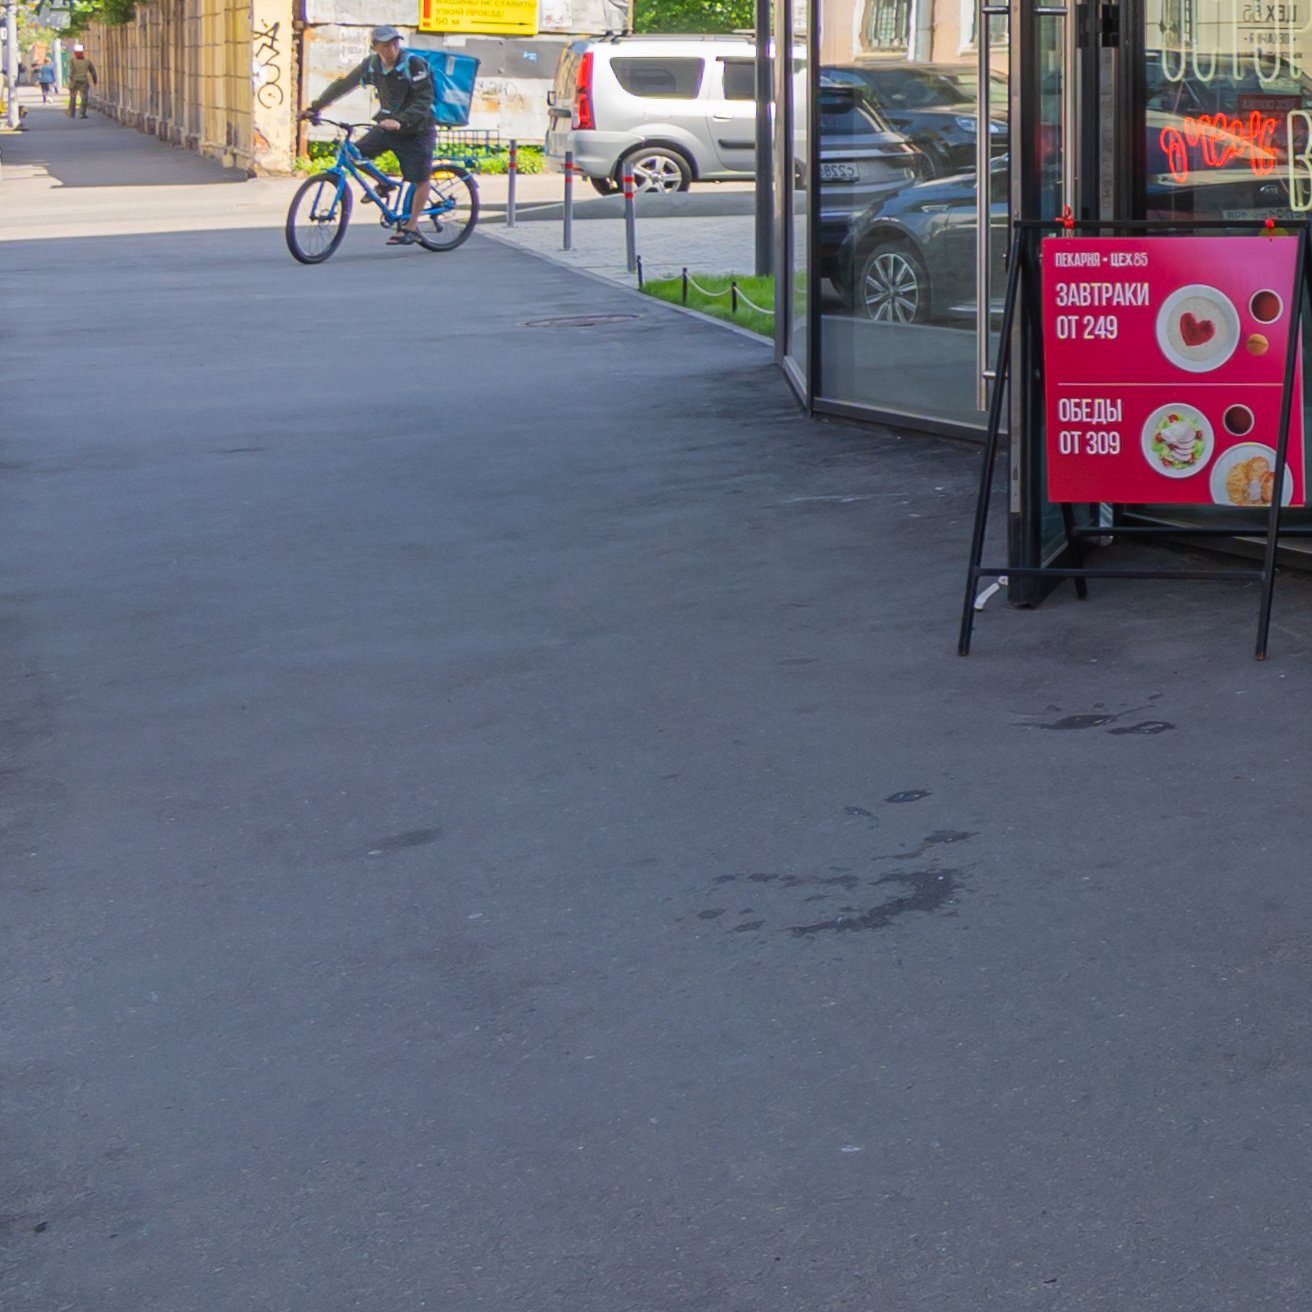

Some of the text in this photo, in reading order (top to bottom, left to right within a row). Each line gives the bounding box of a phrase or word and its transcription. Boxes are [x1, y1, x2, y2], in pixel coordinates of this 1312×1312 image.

[435, 17, 449, 25] 50
[1055, 252, 1101, 267] ПЕКАРНЯ
[1055, 282, 1150, 307] ЗАВТРАКИ
[1056, 315, 1119, 340] ОТ 249
[1059, 398, 1122, 425] ОБЕДЫ
[1060, 430, 1121, 455] ОТ 309
